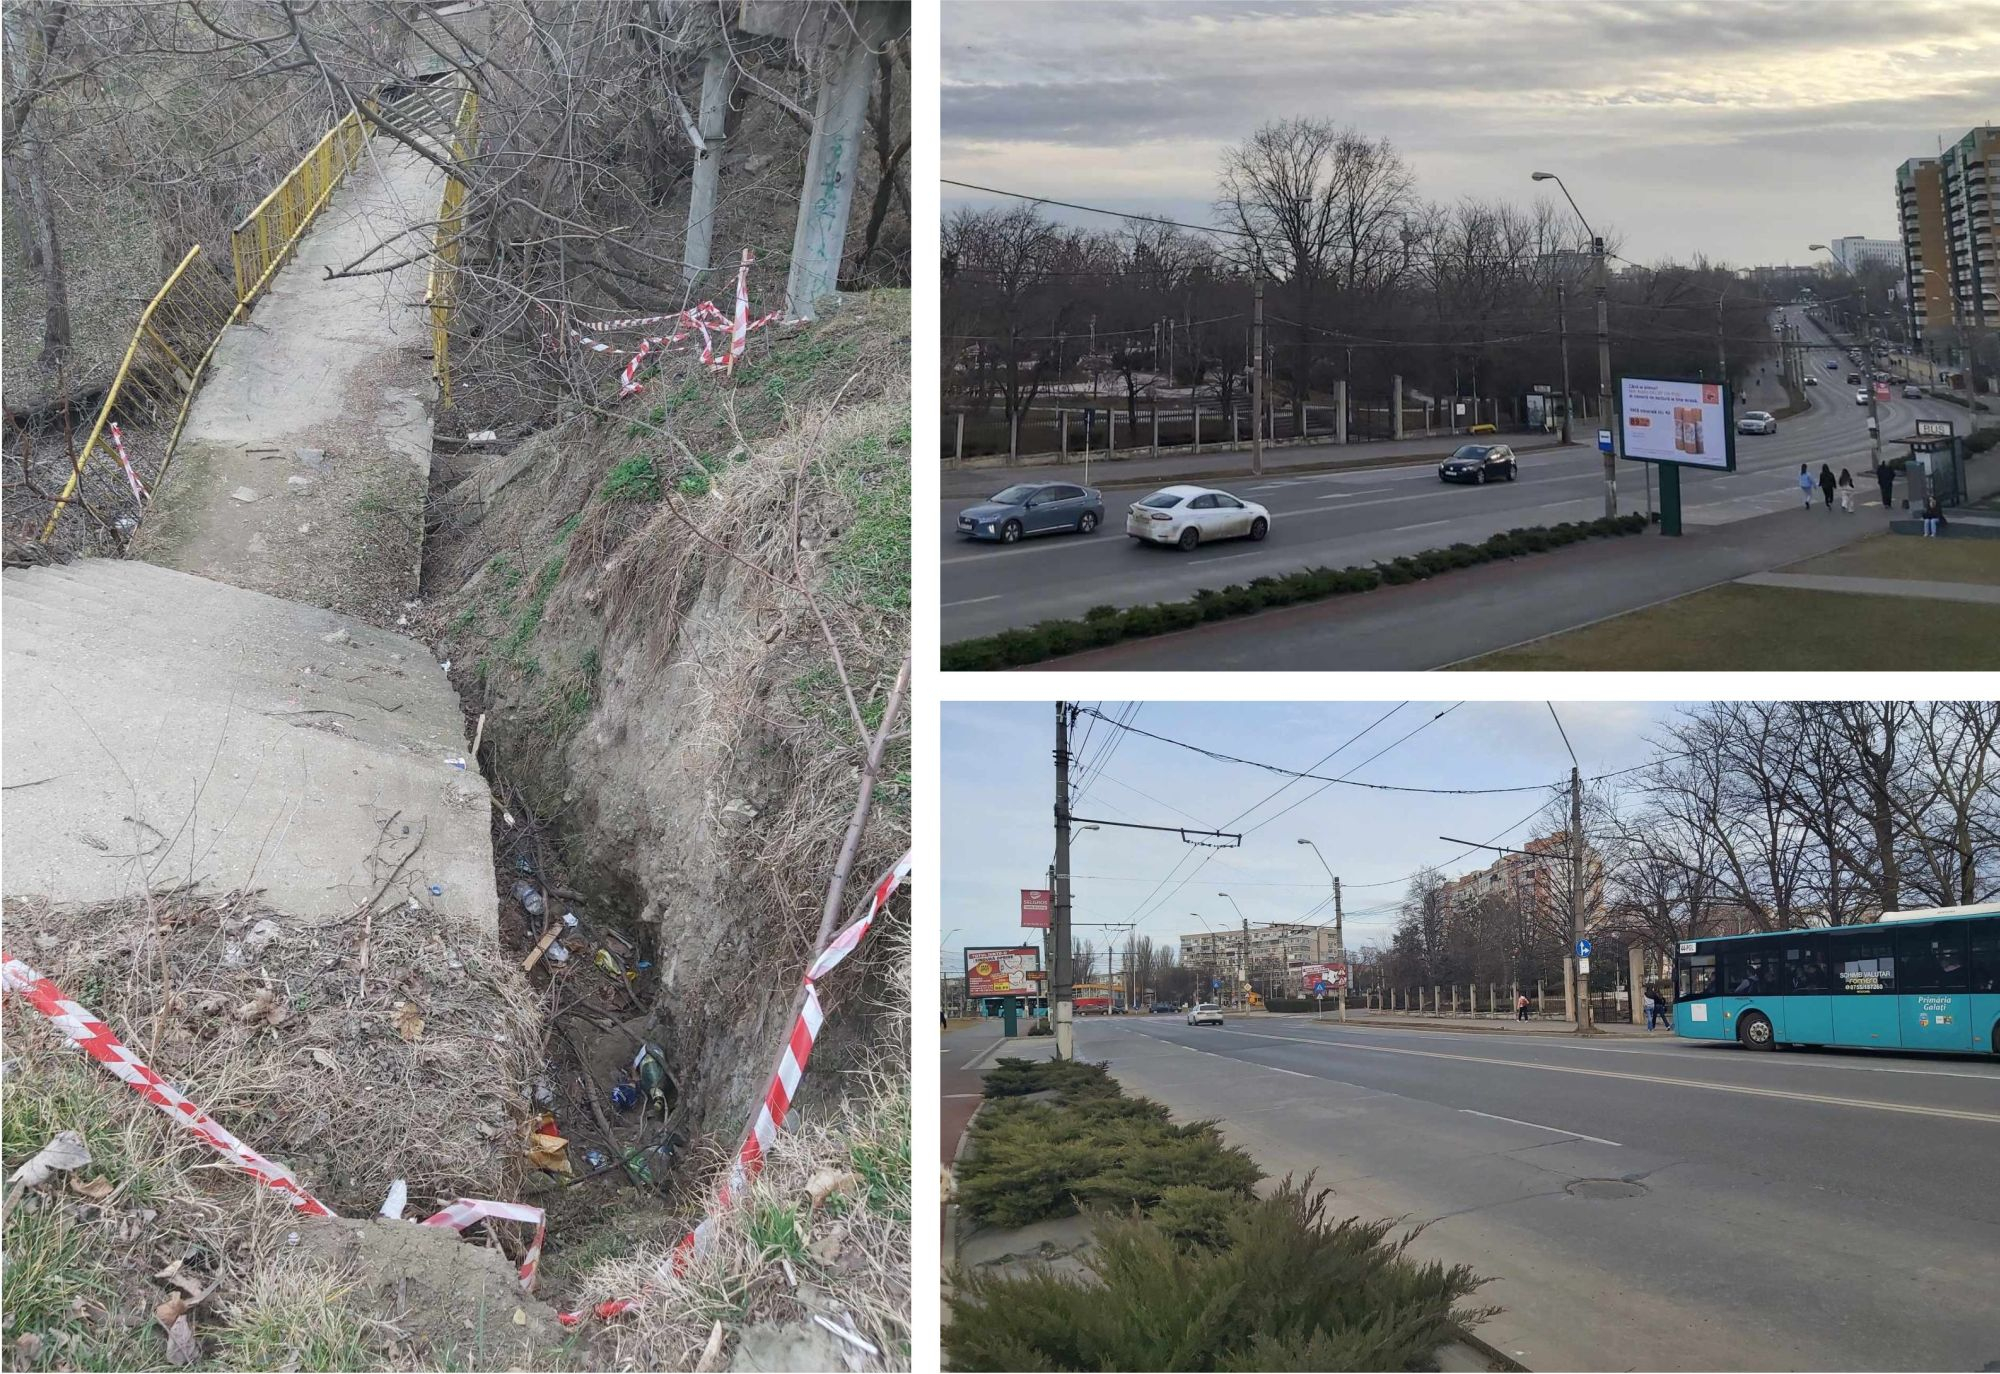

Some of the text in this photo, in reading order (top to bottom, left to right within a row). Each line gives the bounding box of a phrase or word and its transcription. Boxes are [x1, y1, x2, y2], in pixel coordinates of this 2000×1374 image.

[1923, 424, 1945, 434] BUS
[1840, 970, 1890, 979] SCHIMB VALUTAR
